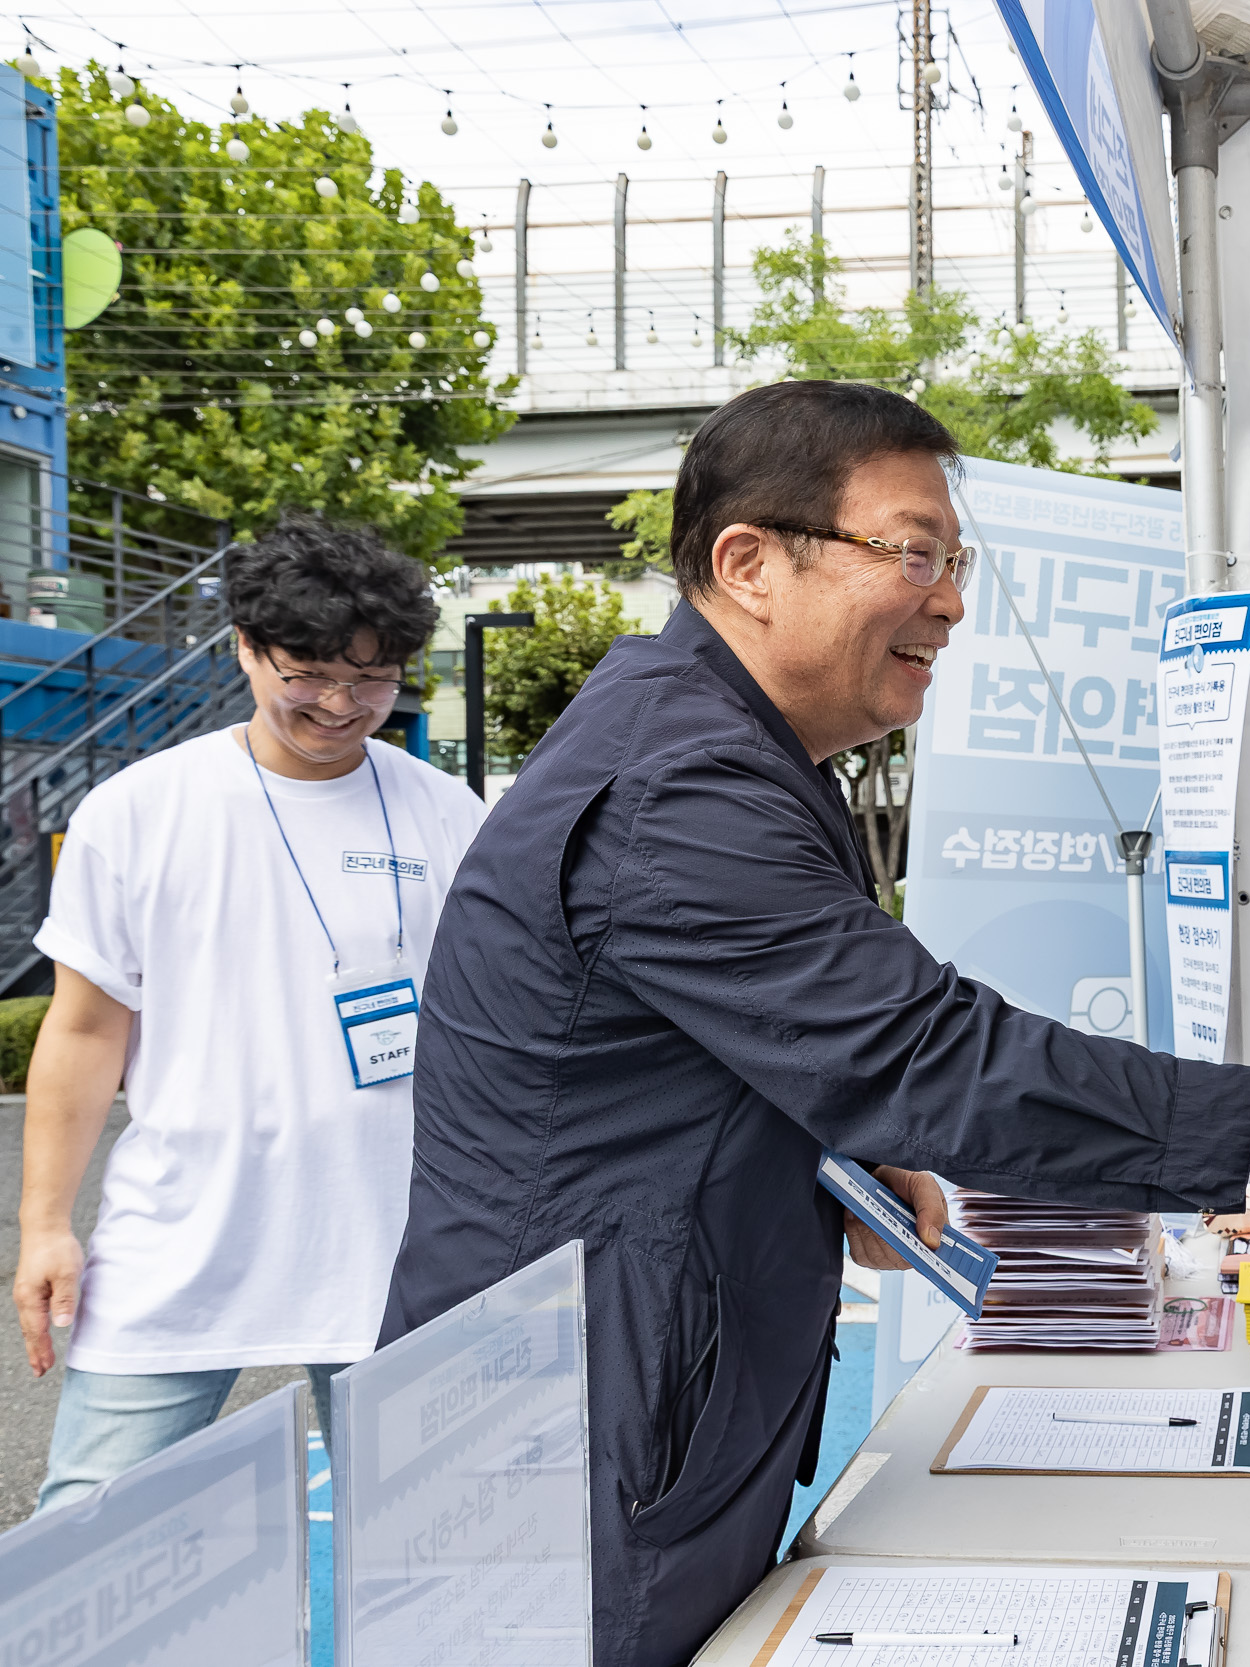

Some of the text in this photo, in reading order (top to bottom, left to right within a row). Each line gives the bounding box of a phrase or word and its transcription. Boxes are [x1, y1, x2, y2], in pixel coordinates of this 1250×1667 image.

[1174, 621, 1222, 645] 진구네 편의점
[345, 855, 425, 876] 진구네 편의점
[1194, 877, 1212, 894] 편의점
[1192, 926, 1221, 950] 접수하기
[369, 1046, 411, 1065] STAFF
